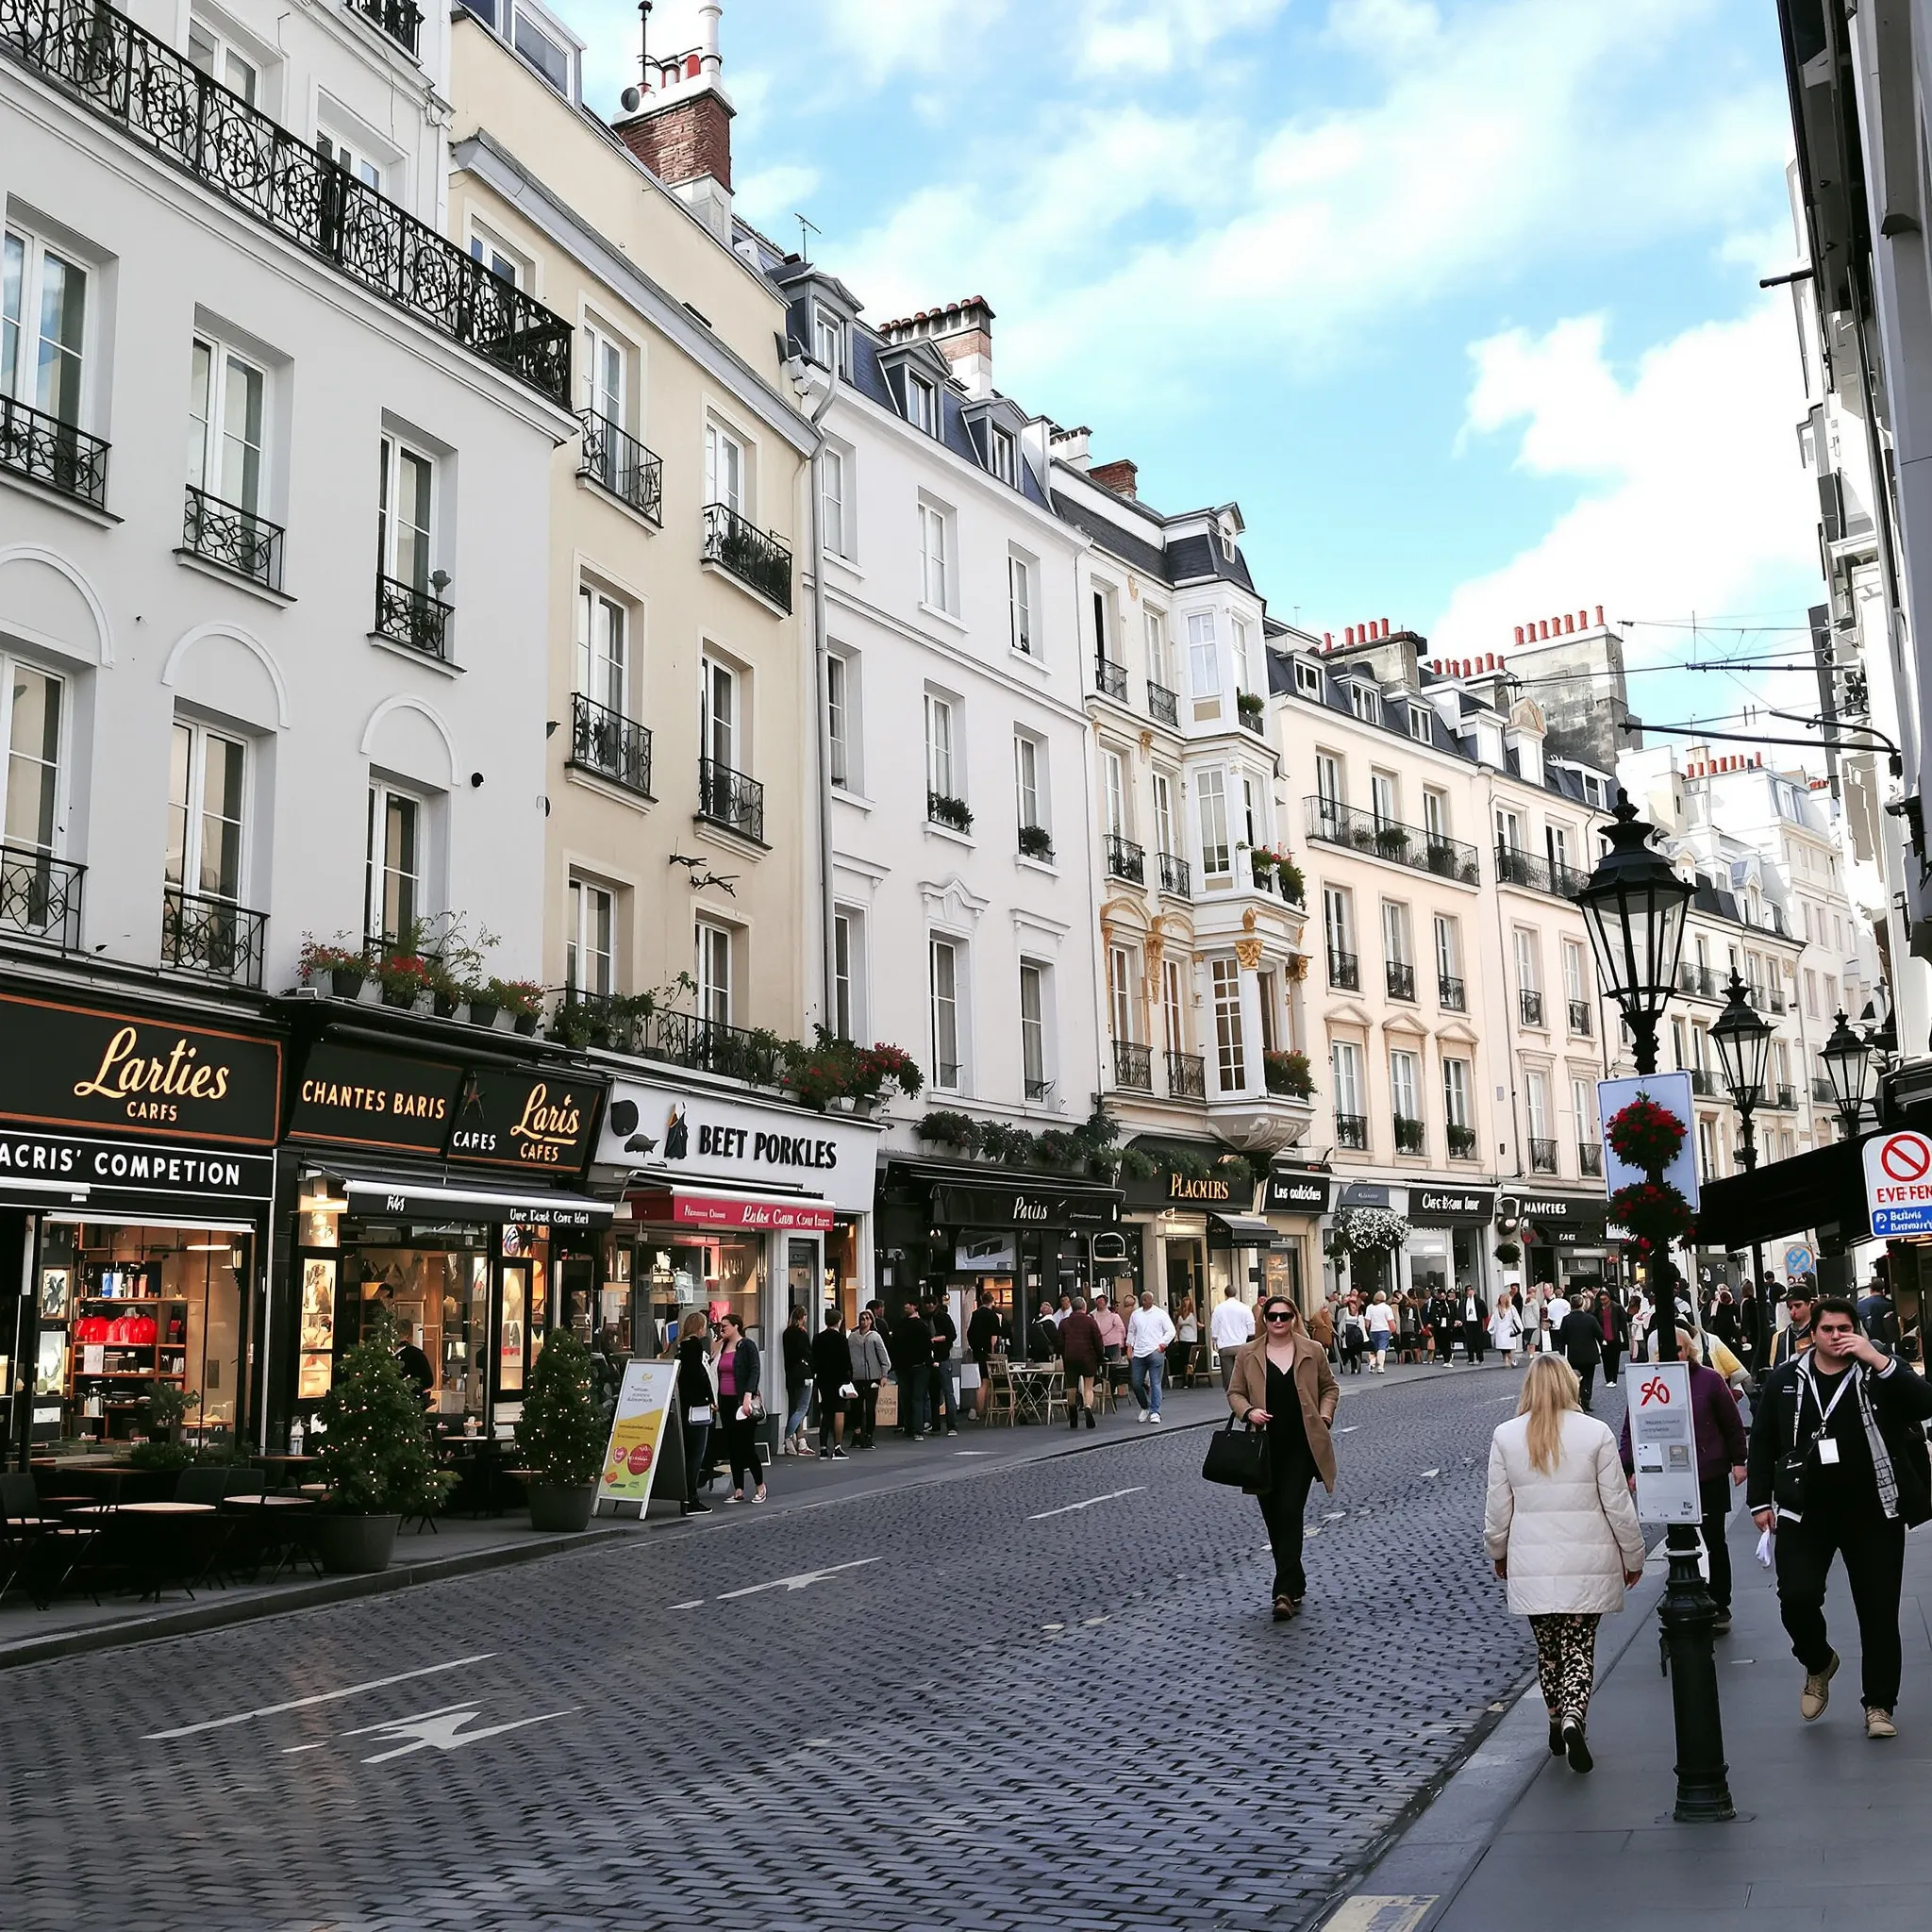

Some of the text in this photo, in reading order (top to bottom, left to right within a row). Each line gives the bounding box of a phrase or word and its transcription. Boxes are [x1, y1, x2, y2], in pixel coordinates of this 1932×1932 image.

[74, 1026, 229, 1100] Larties
[126, 1101, 177, 1123] CARFS
[302, 1080, 445, 1120] CHANTES BARIS
[520, 1142, 558, 1162] CAFES
[699, 1124, 838, 1169] BEET PORKLES
[94, 1152, 240, 1186] COMPETION
